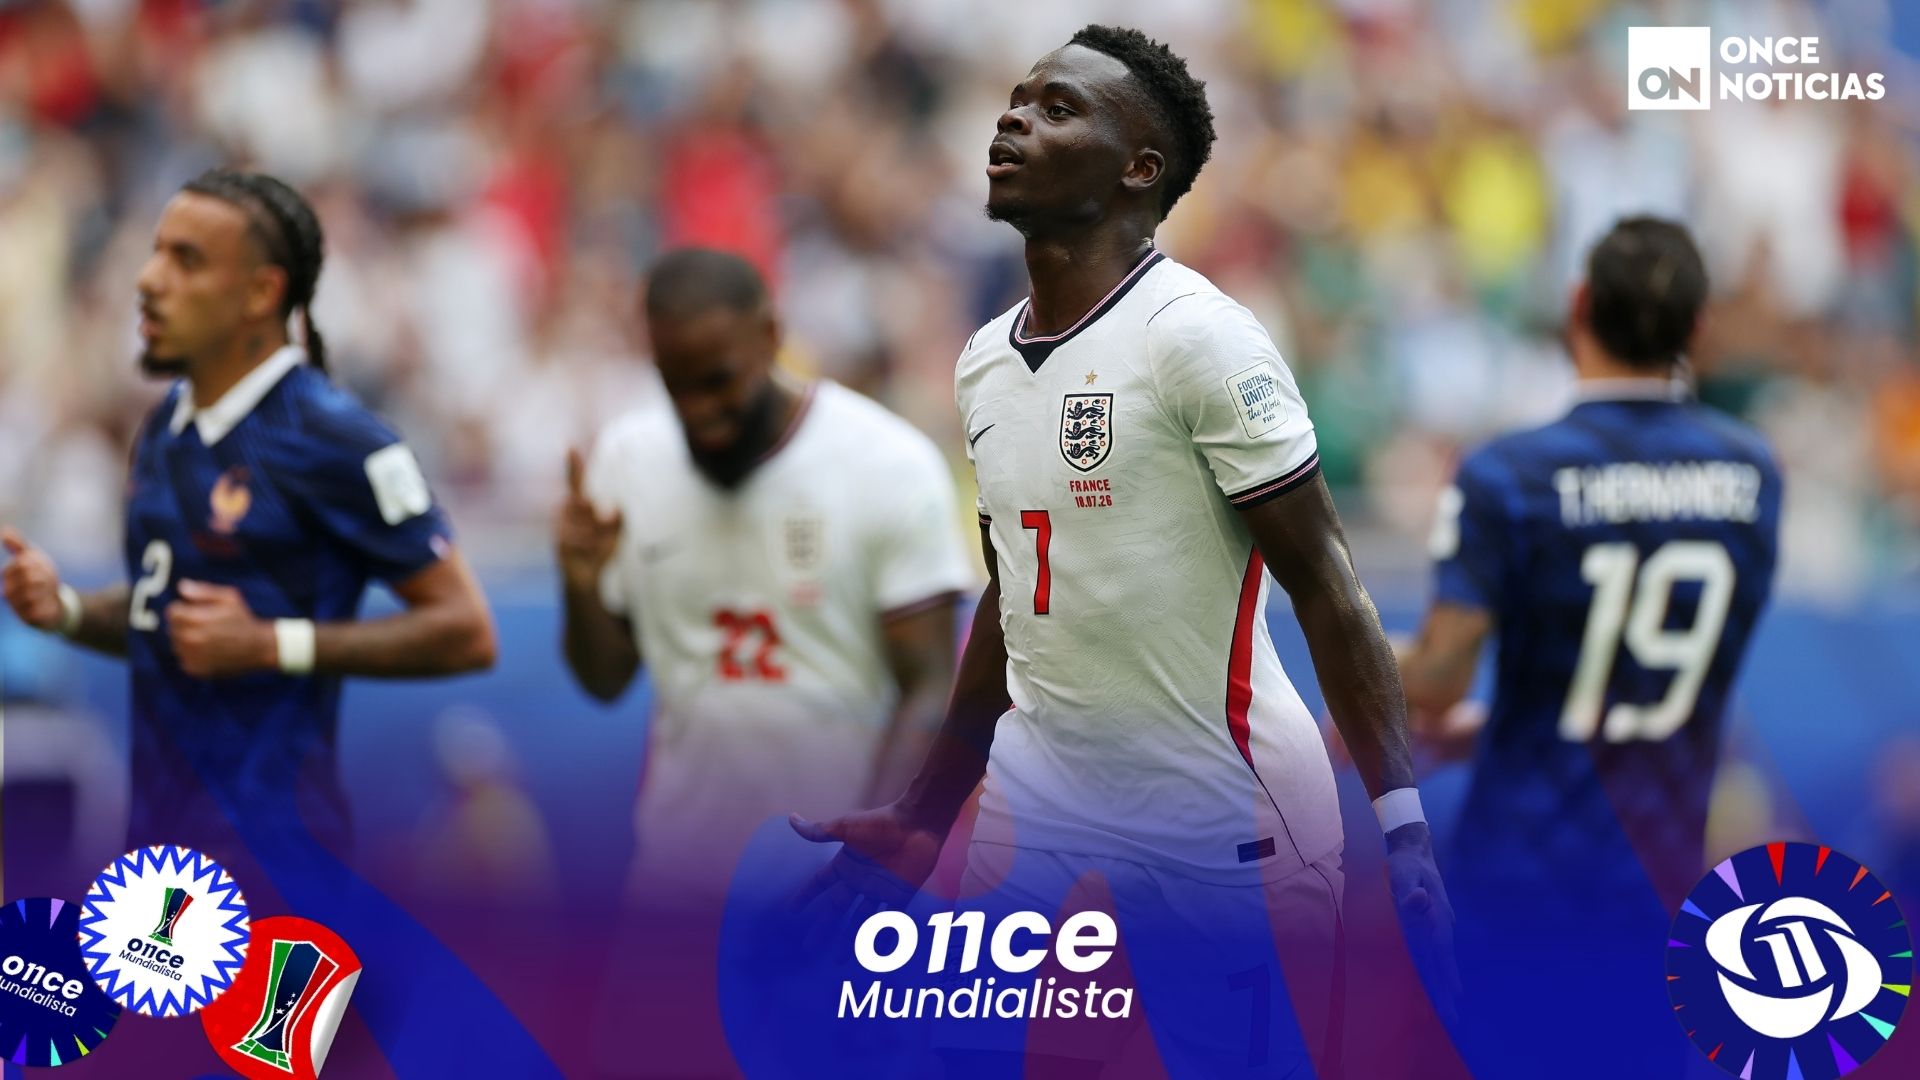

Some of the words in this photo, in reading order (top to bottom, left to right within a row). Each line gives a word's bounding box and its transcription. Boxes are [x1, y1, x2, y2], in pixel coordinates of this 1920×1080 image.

[1237, 372, 1272, 393] FOOTBALL
[1242, 381, 1274, 407] UNITES
[1246, 407, 1262, 420] the
[1263, 414, 1276, 423] FIFA
[1069, 478, 1111, 493] FRANCE
[1020, 510, 1051, 615] 7
[129, 539, 173, 632] 2
[712, 606, 788, 682] 22
[1558, 541, 1736, 743] 19
